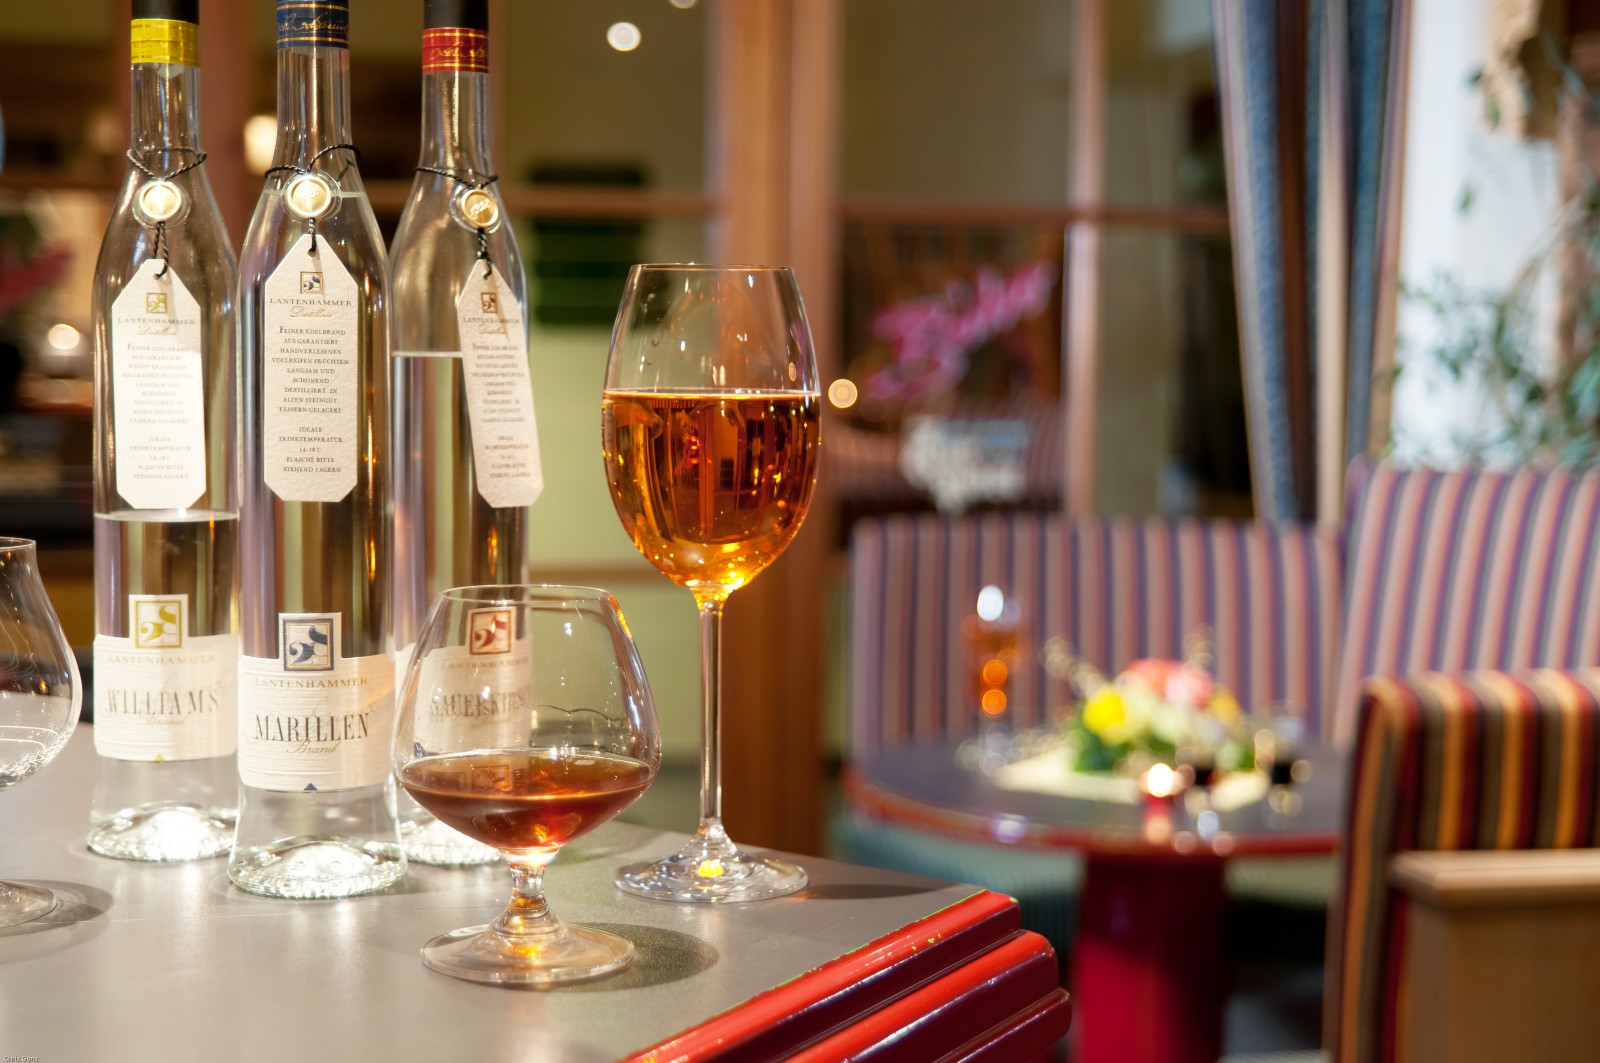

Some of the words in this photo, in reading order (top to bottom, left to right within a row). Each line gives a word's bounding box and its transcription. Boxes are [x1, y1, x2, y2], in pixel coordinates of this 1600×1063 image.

[270, 298, 352, 306] LANTENHAMMER
[118, 317, 196, 325] LANTENHAMMER
[108, 654, 216, 665] LANTENHAMMER
[254, 678, 368, 688] LANTENHAMMER
[107, 688, 219, 716] WILLIAMS
[255, 712, 370, 742] MARILLEN
[286, 738, 342, 754] Brand
